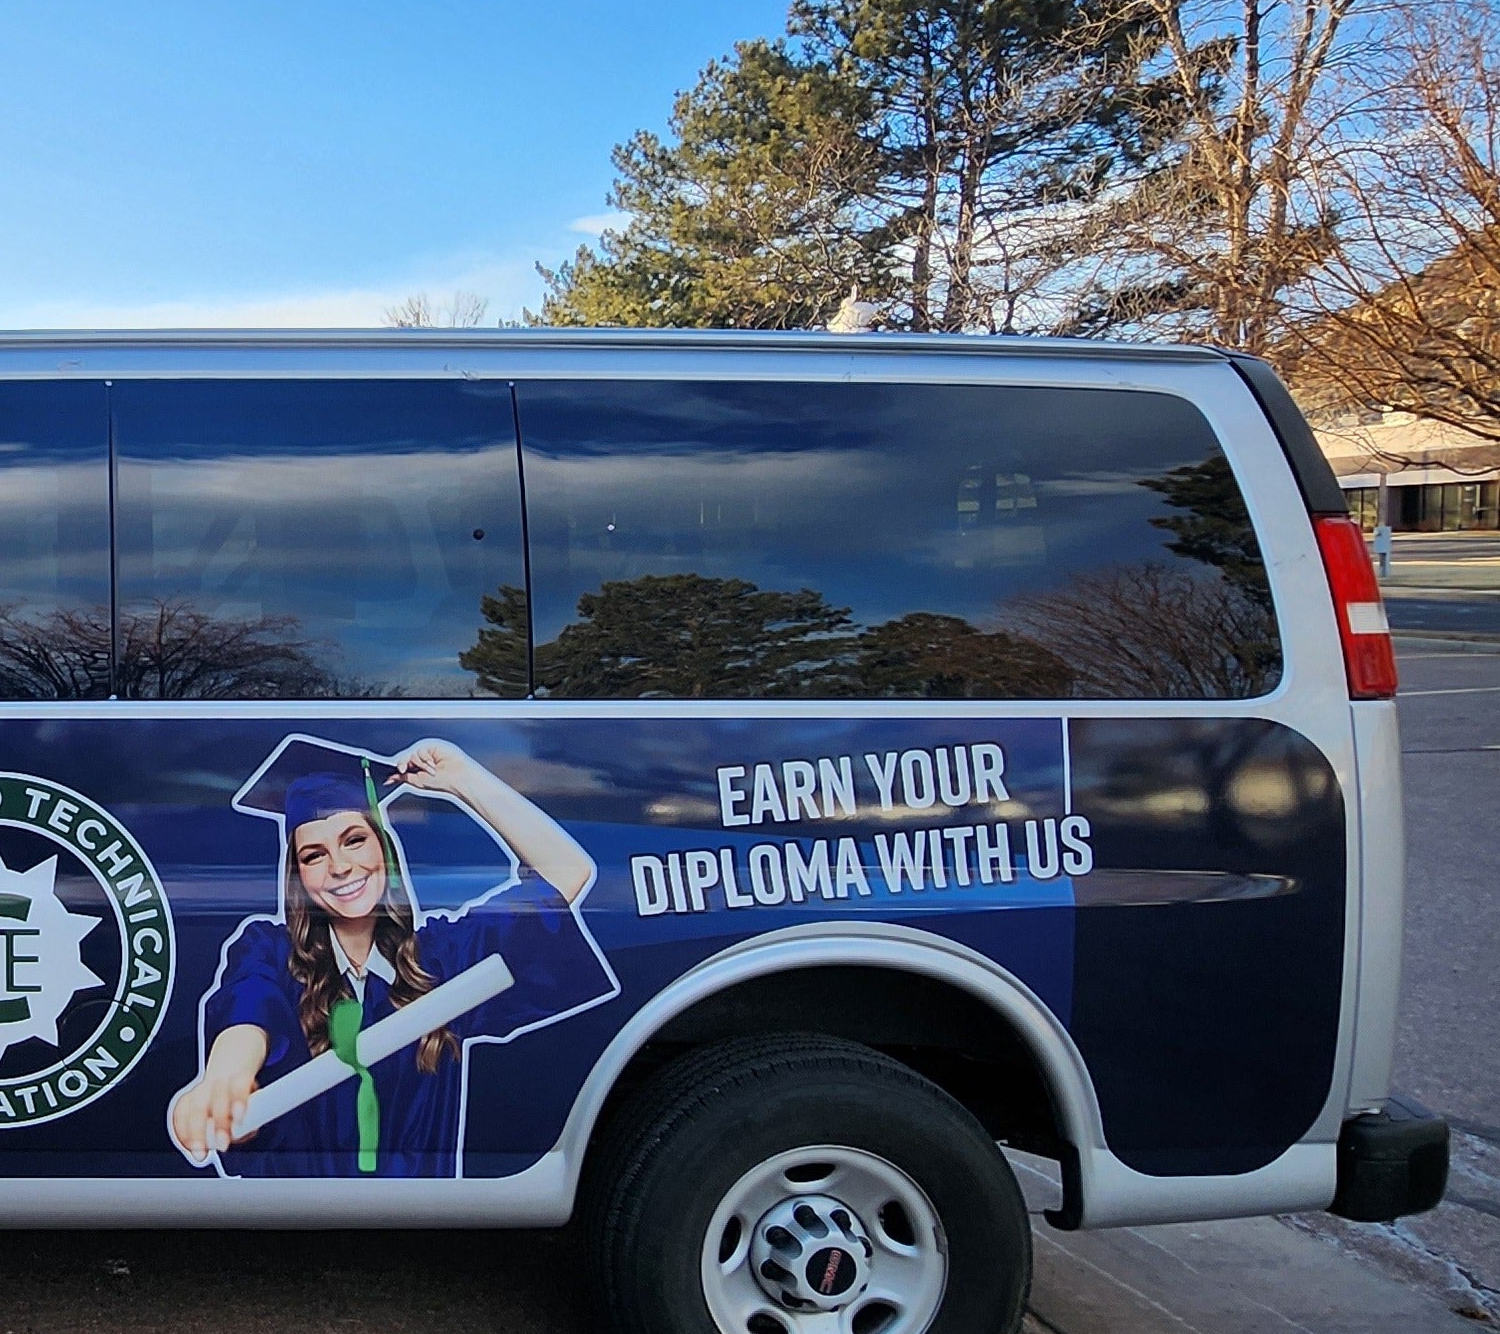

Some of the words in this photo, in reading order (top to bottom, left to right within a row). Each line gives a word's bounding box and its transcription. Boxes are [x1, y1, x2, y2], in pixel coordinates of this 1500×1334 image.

[717, 756, 857, 827] EARN
[865, 743, 1010, 812] YOUR
[25, 787, 163, 1013] TECHNICAL
[631, 834, 871, 916] DIPLOMA
[875, 823, 1013, 893] WITH
[1025, 816, 1093, 880] US
[820, 1250, 841, 1294] GMC
